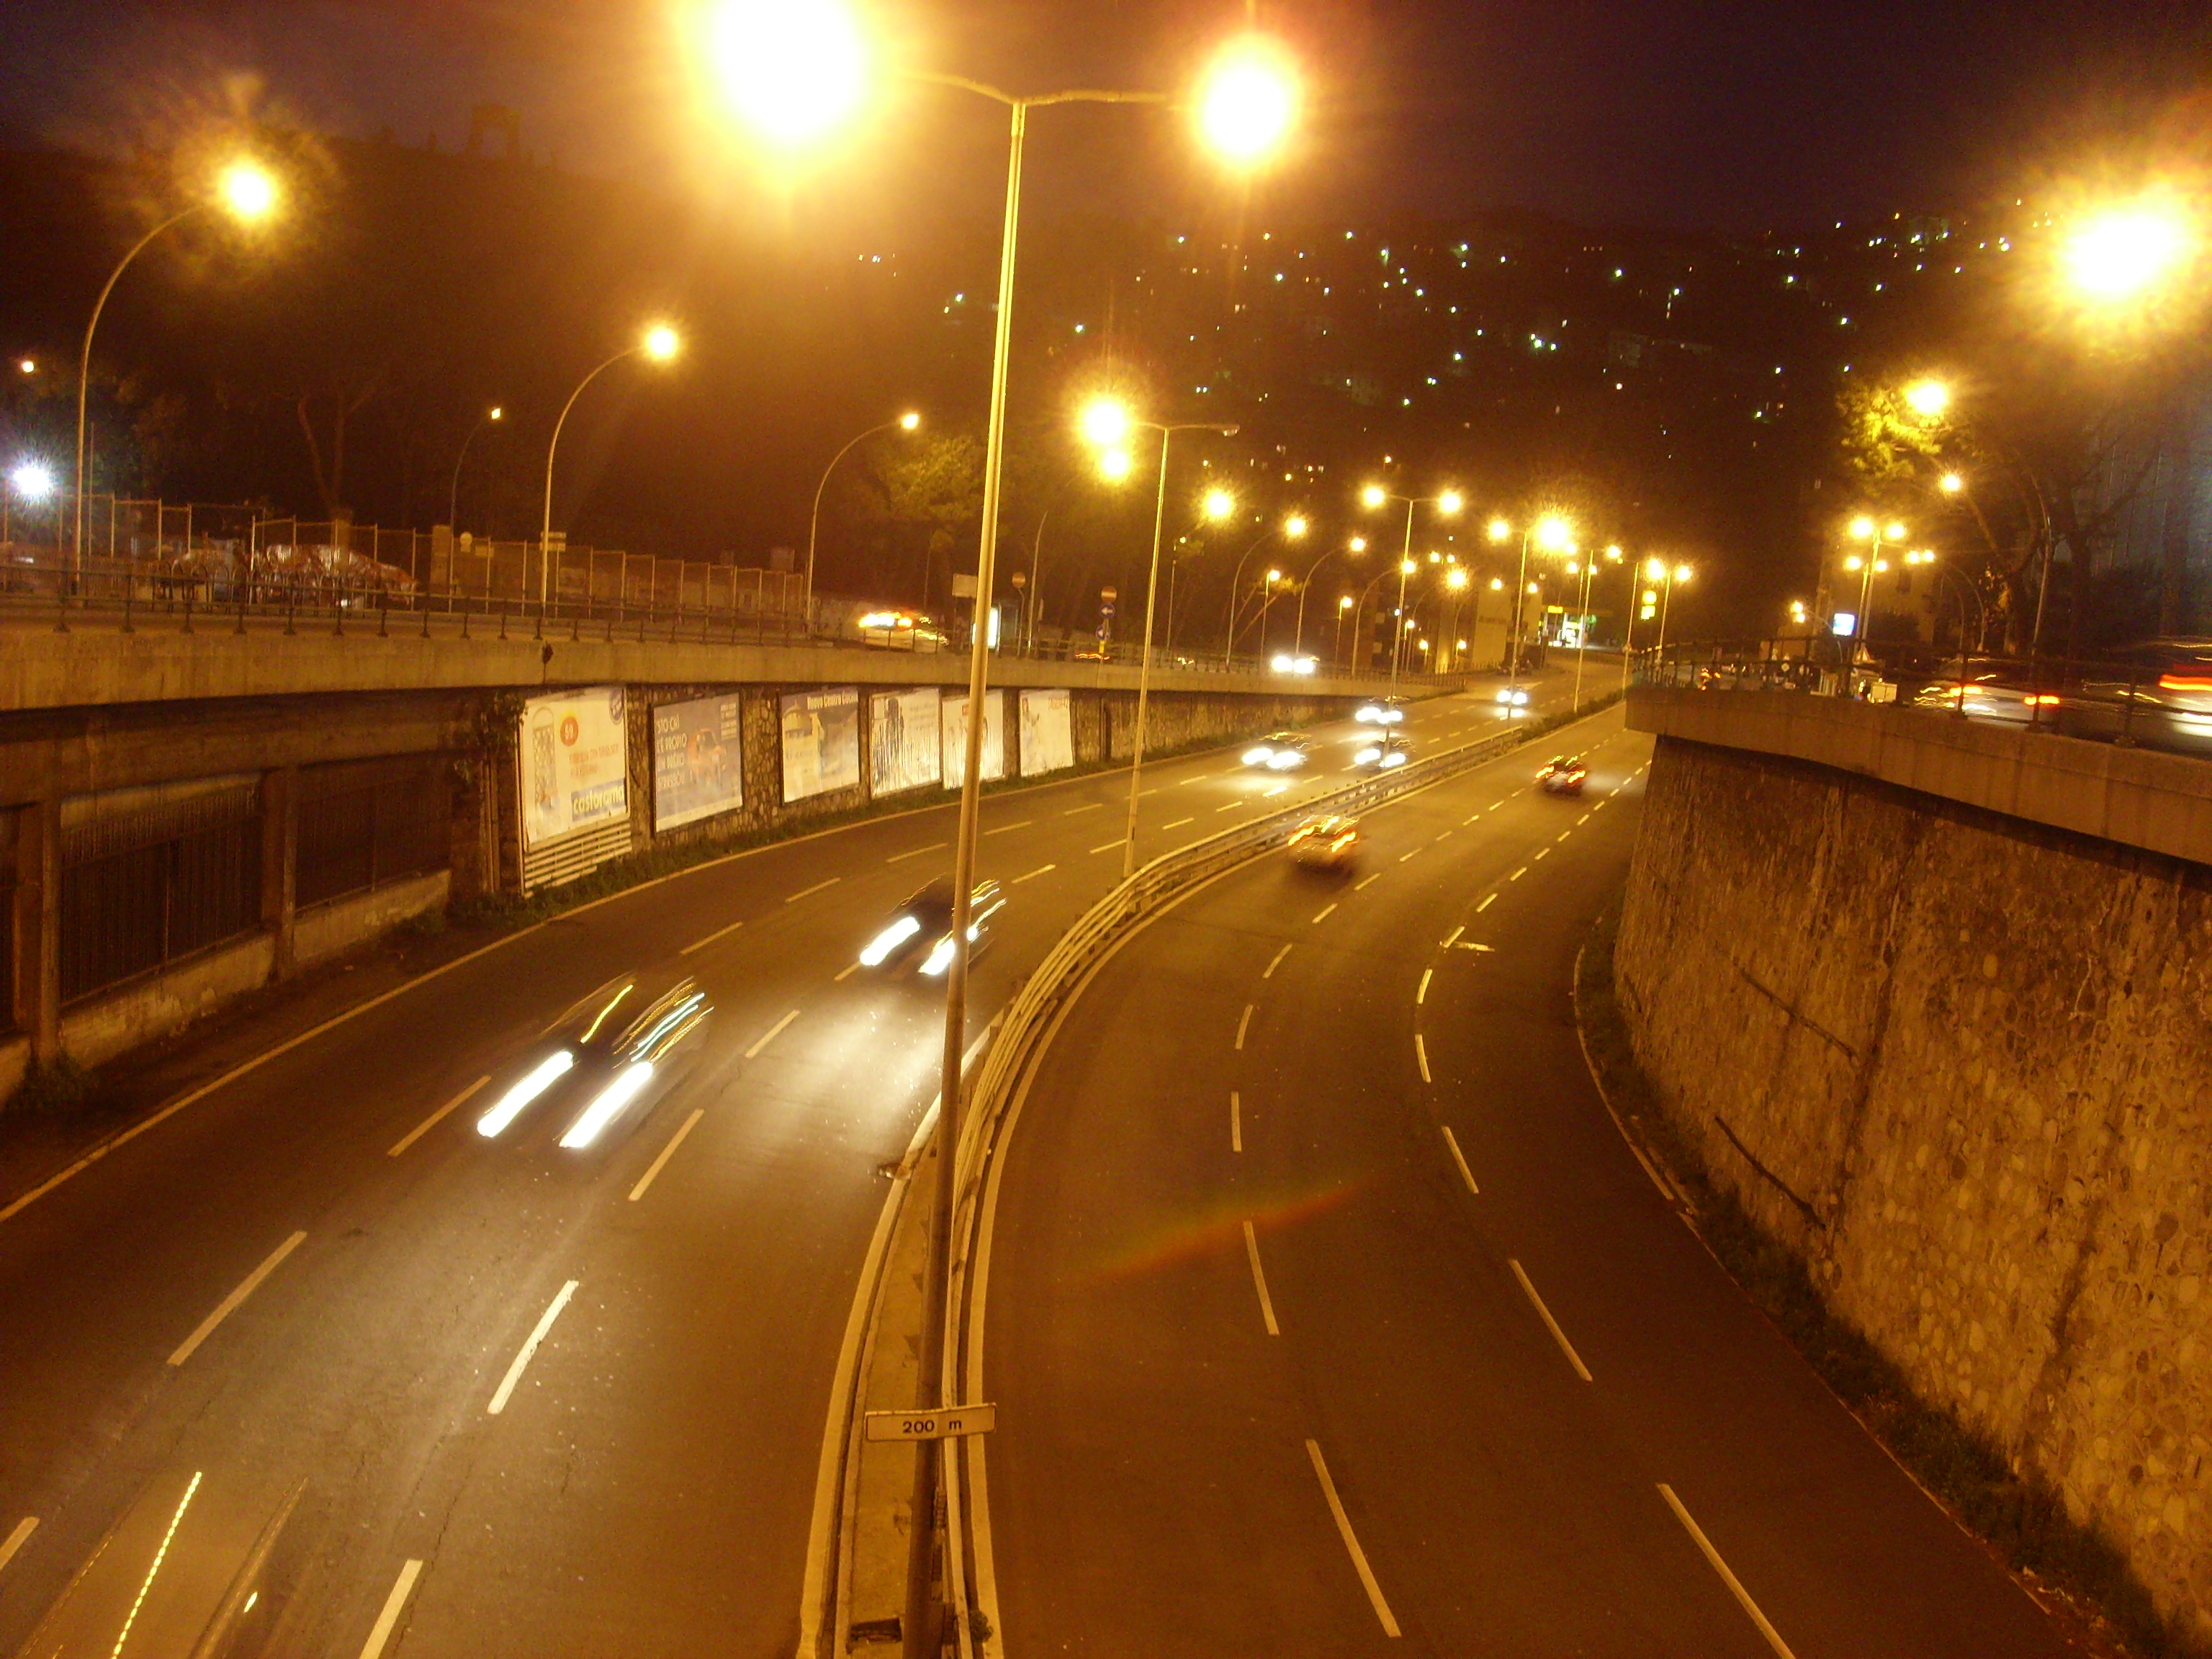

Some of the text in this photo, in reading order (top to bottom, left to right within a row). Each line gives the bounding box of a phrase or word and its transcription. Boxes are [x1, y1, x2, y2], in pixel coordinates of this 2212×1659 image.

[572, 786, 624, 814] castorama
[902, 1419, 963, 1434] 200 m
